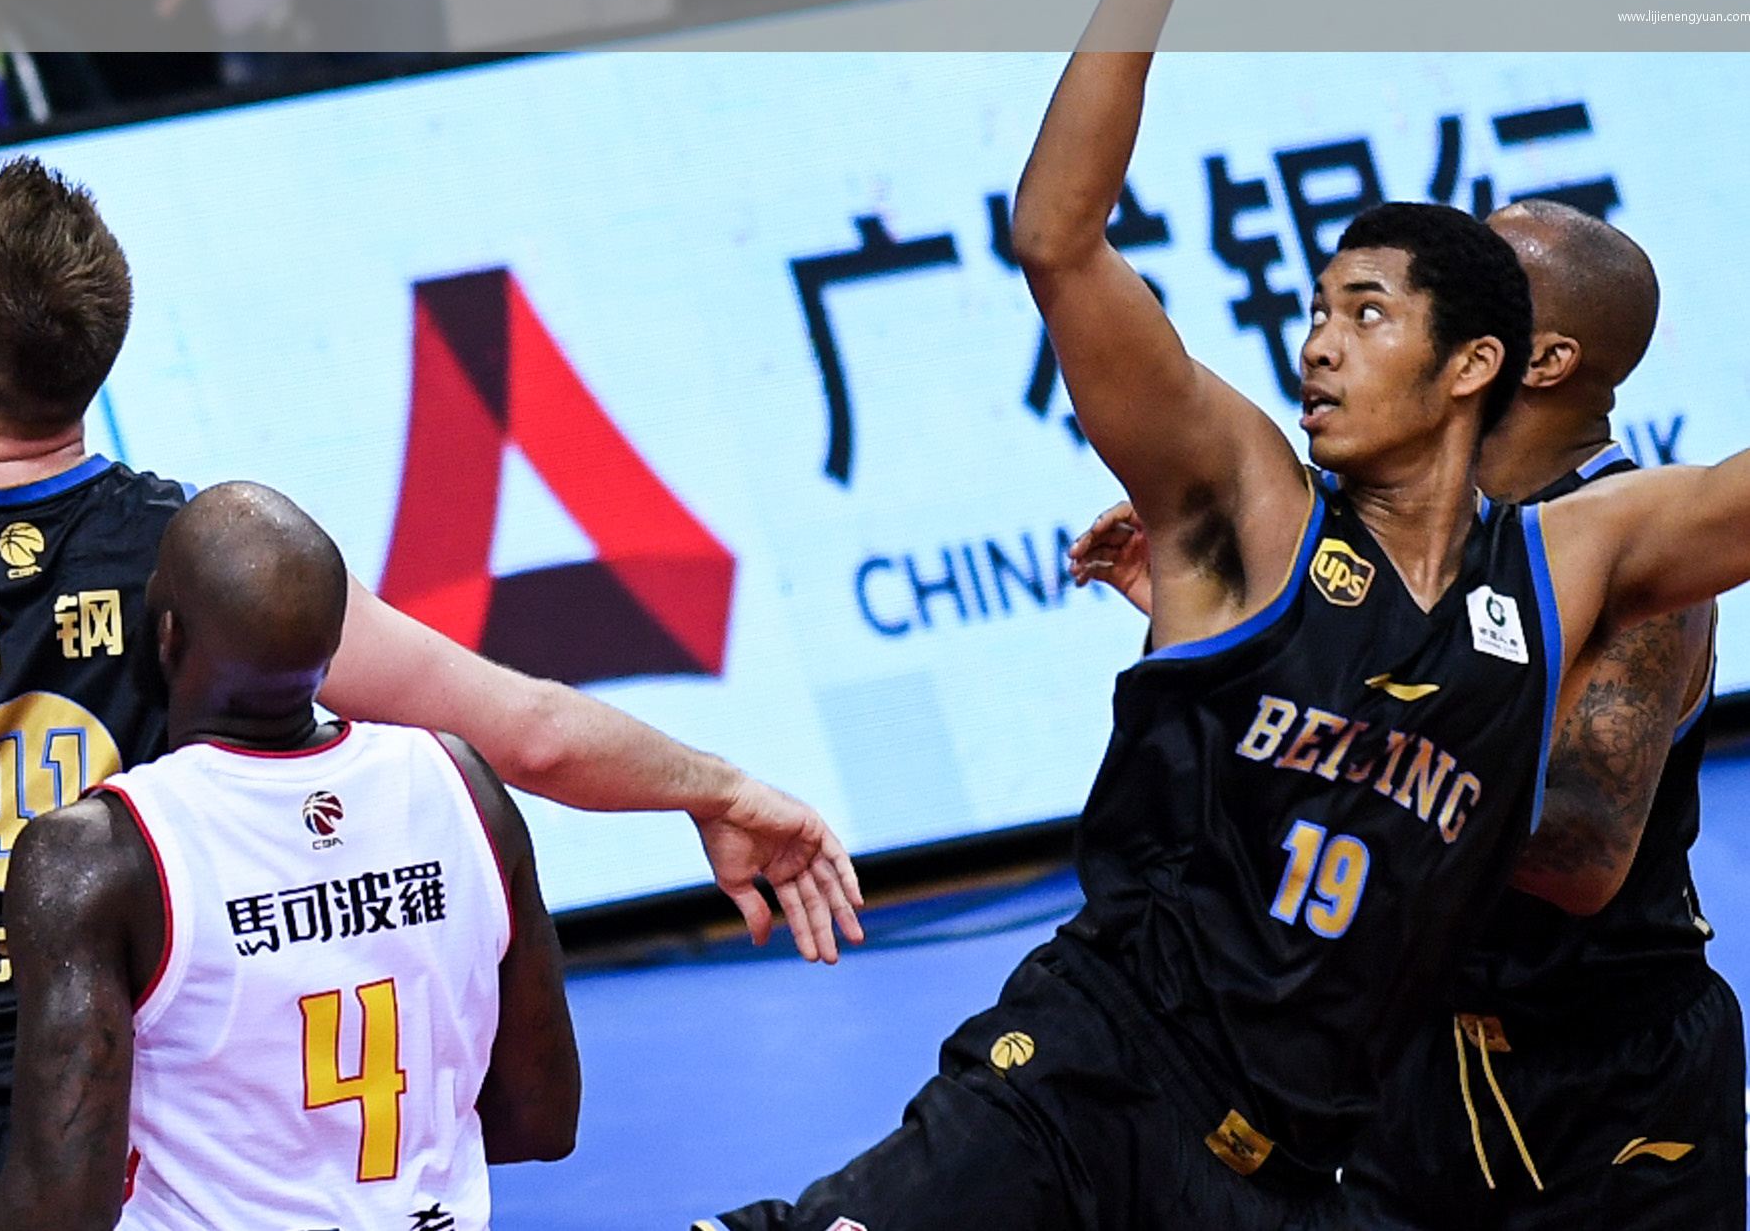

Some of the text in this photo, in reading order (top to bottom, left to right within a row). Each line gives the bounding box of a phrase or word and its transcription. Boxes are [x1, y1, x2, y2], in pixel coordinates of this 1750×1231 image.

[1315, 552, 1365, 599] ups
[311, 837, 344, 850] CBA
[1269, 819, 1371, 939] 19
[225, 860, 447, 957] 馬可波羅
[297, 977, 407, 1183] 4
